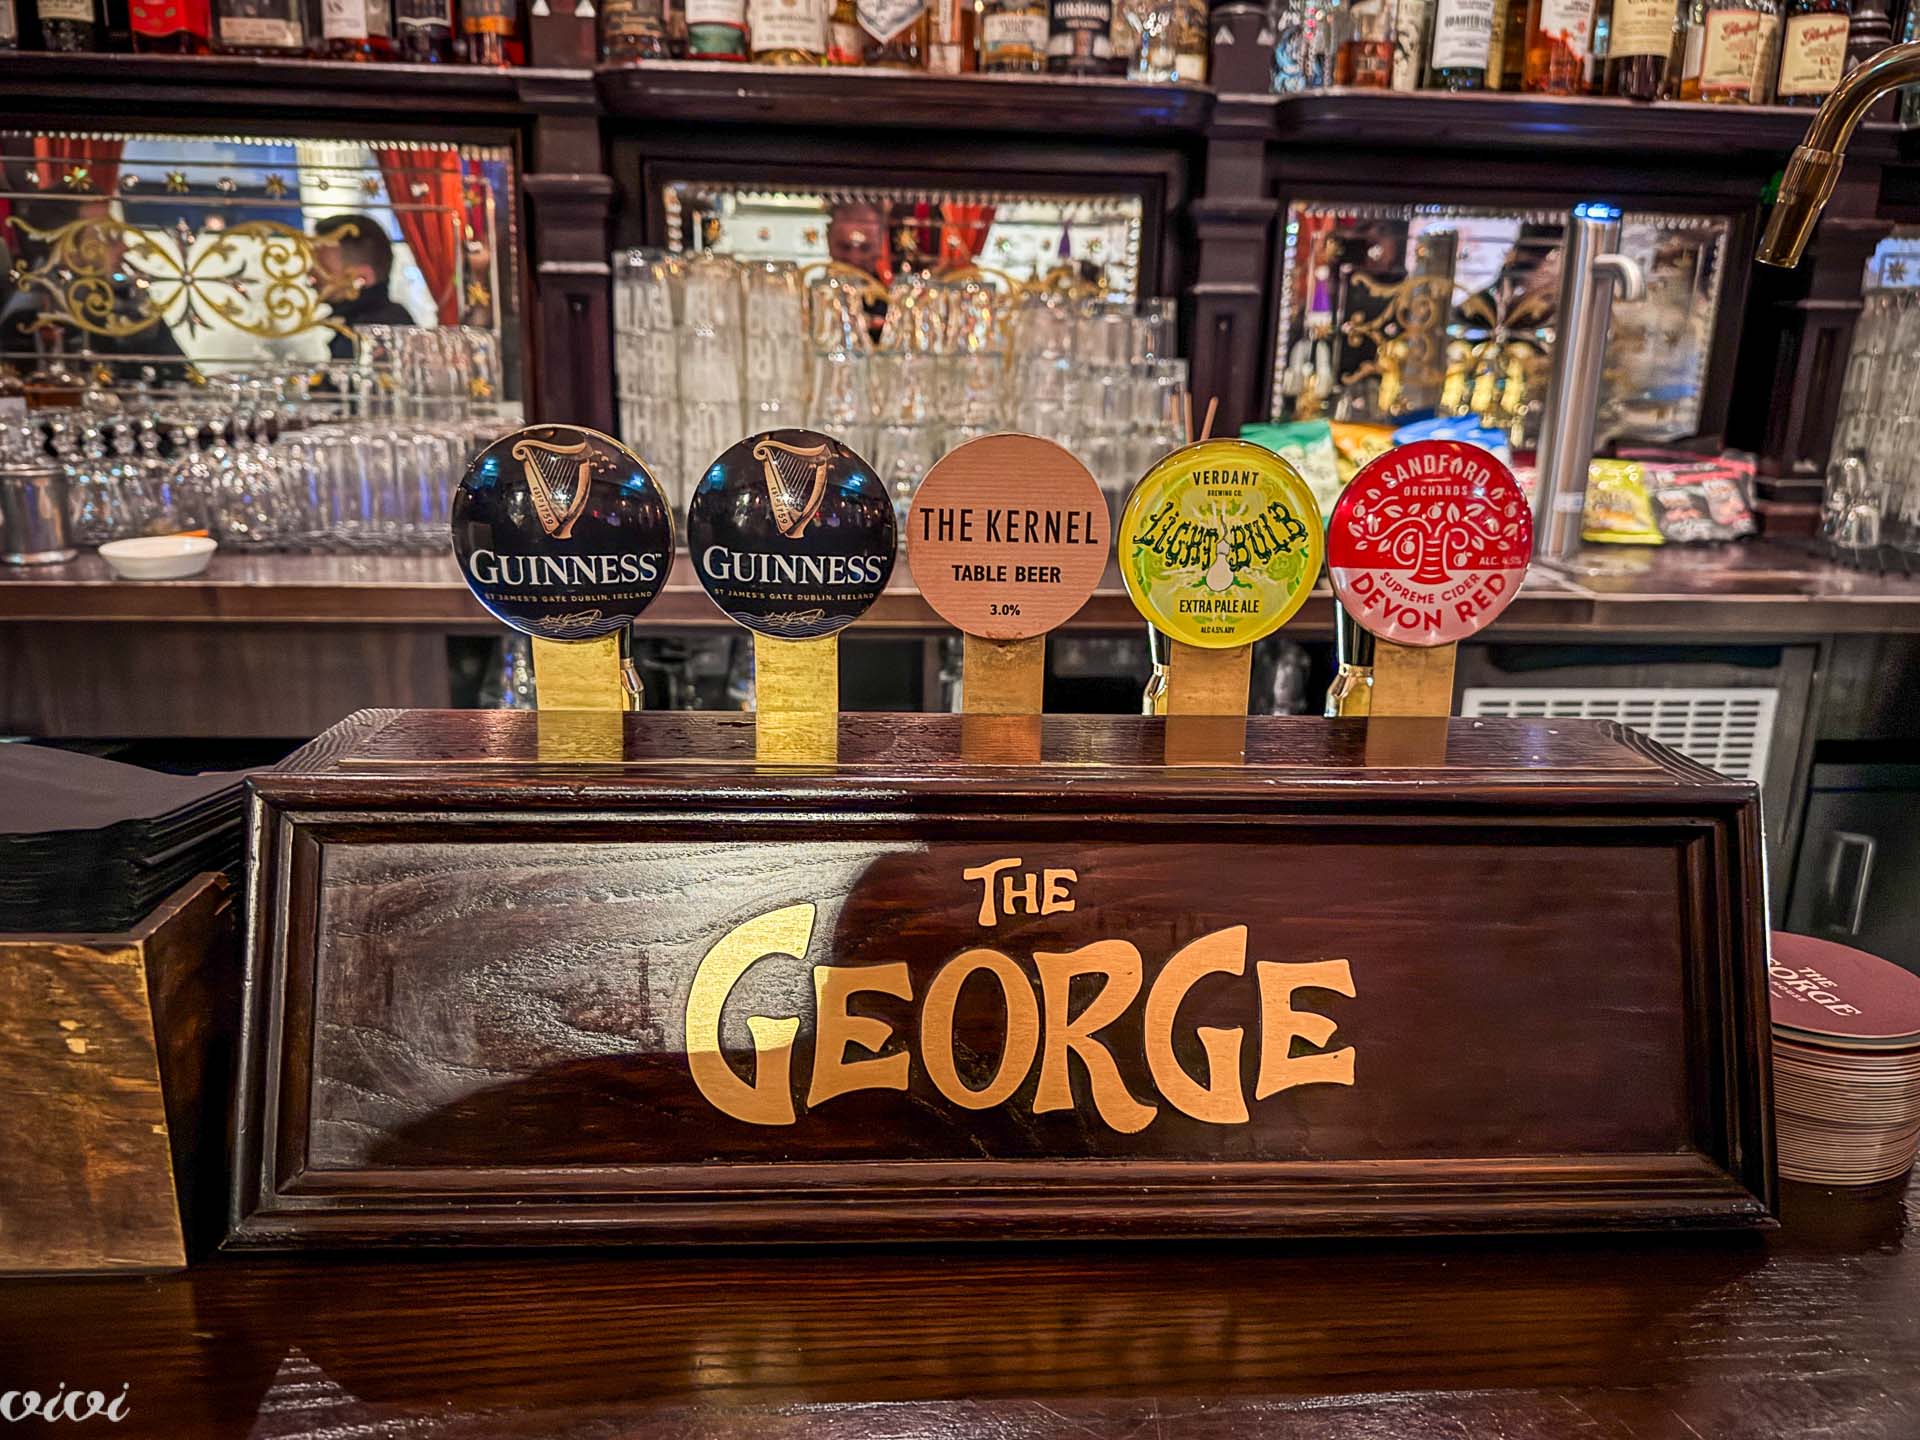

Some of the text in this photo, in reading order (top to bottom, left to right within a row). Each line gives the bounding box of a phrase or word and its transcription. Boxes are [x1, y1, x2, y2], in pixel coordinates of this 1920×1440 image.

[1193, 471, 1259, 486] VERDANT
[1381, 454, 1490, 489] SANDFORD
[1404, 485, 1468, 497] ORCHARDS
[920, 507, 1098, 545] THE KERNEL
[1228, 502, 1309, 572] BULB
[951, 564, 1061, 583] TABLE BEER
[613, 591, 653, 600] IRELAND
[837, 592, 874, 600] IRELAND
[1380, 571, 1481, 604] SUPREME CIDER
[990, 604, 1021, 617] 3.0%
[1180, 600, 1259, 613] EXTRA PALE ALE
[1351, 572, 1506, 631] DEVON RED
[963, 857, 1078, 927] THE
[1798, 966, 1838, 988] THE
[685, 902, 1357, 1134] GEORGE
